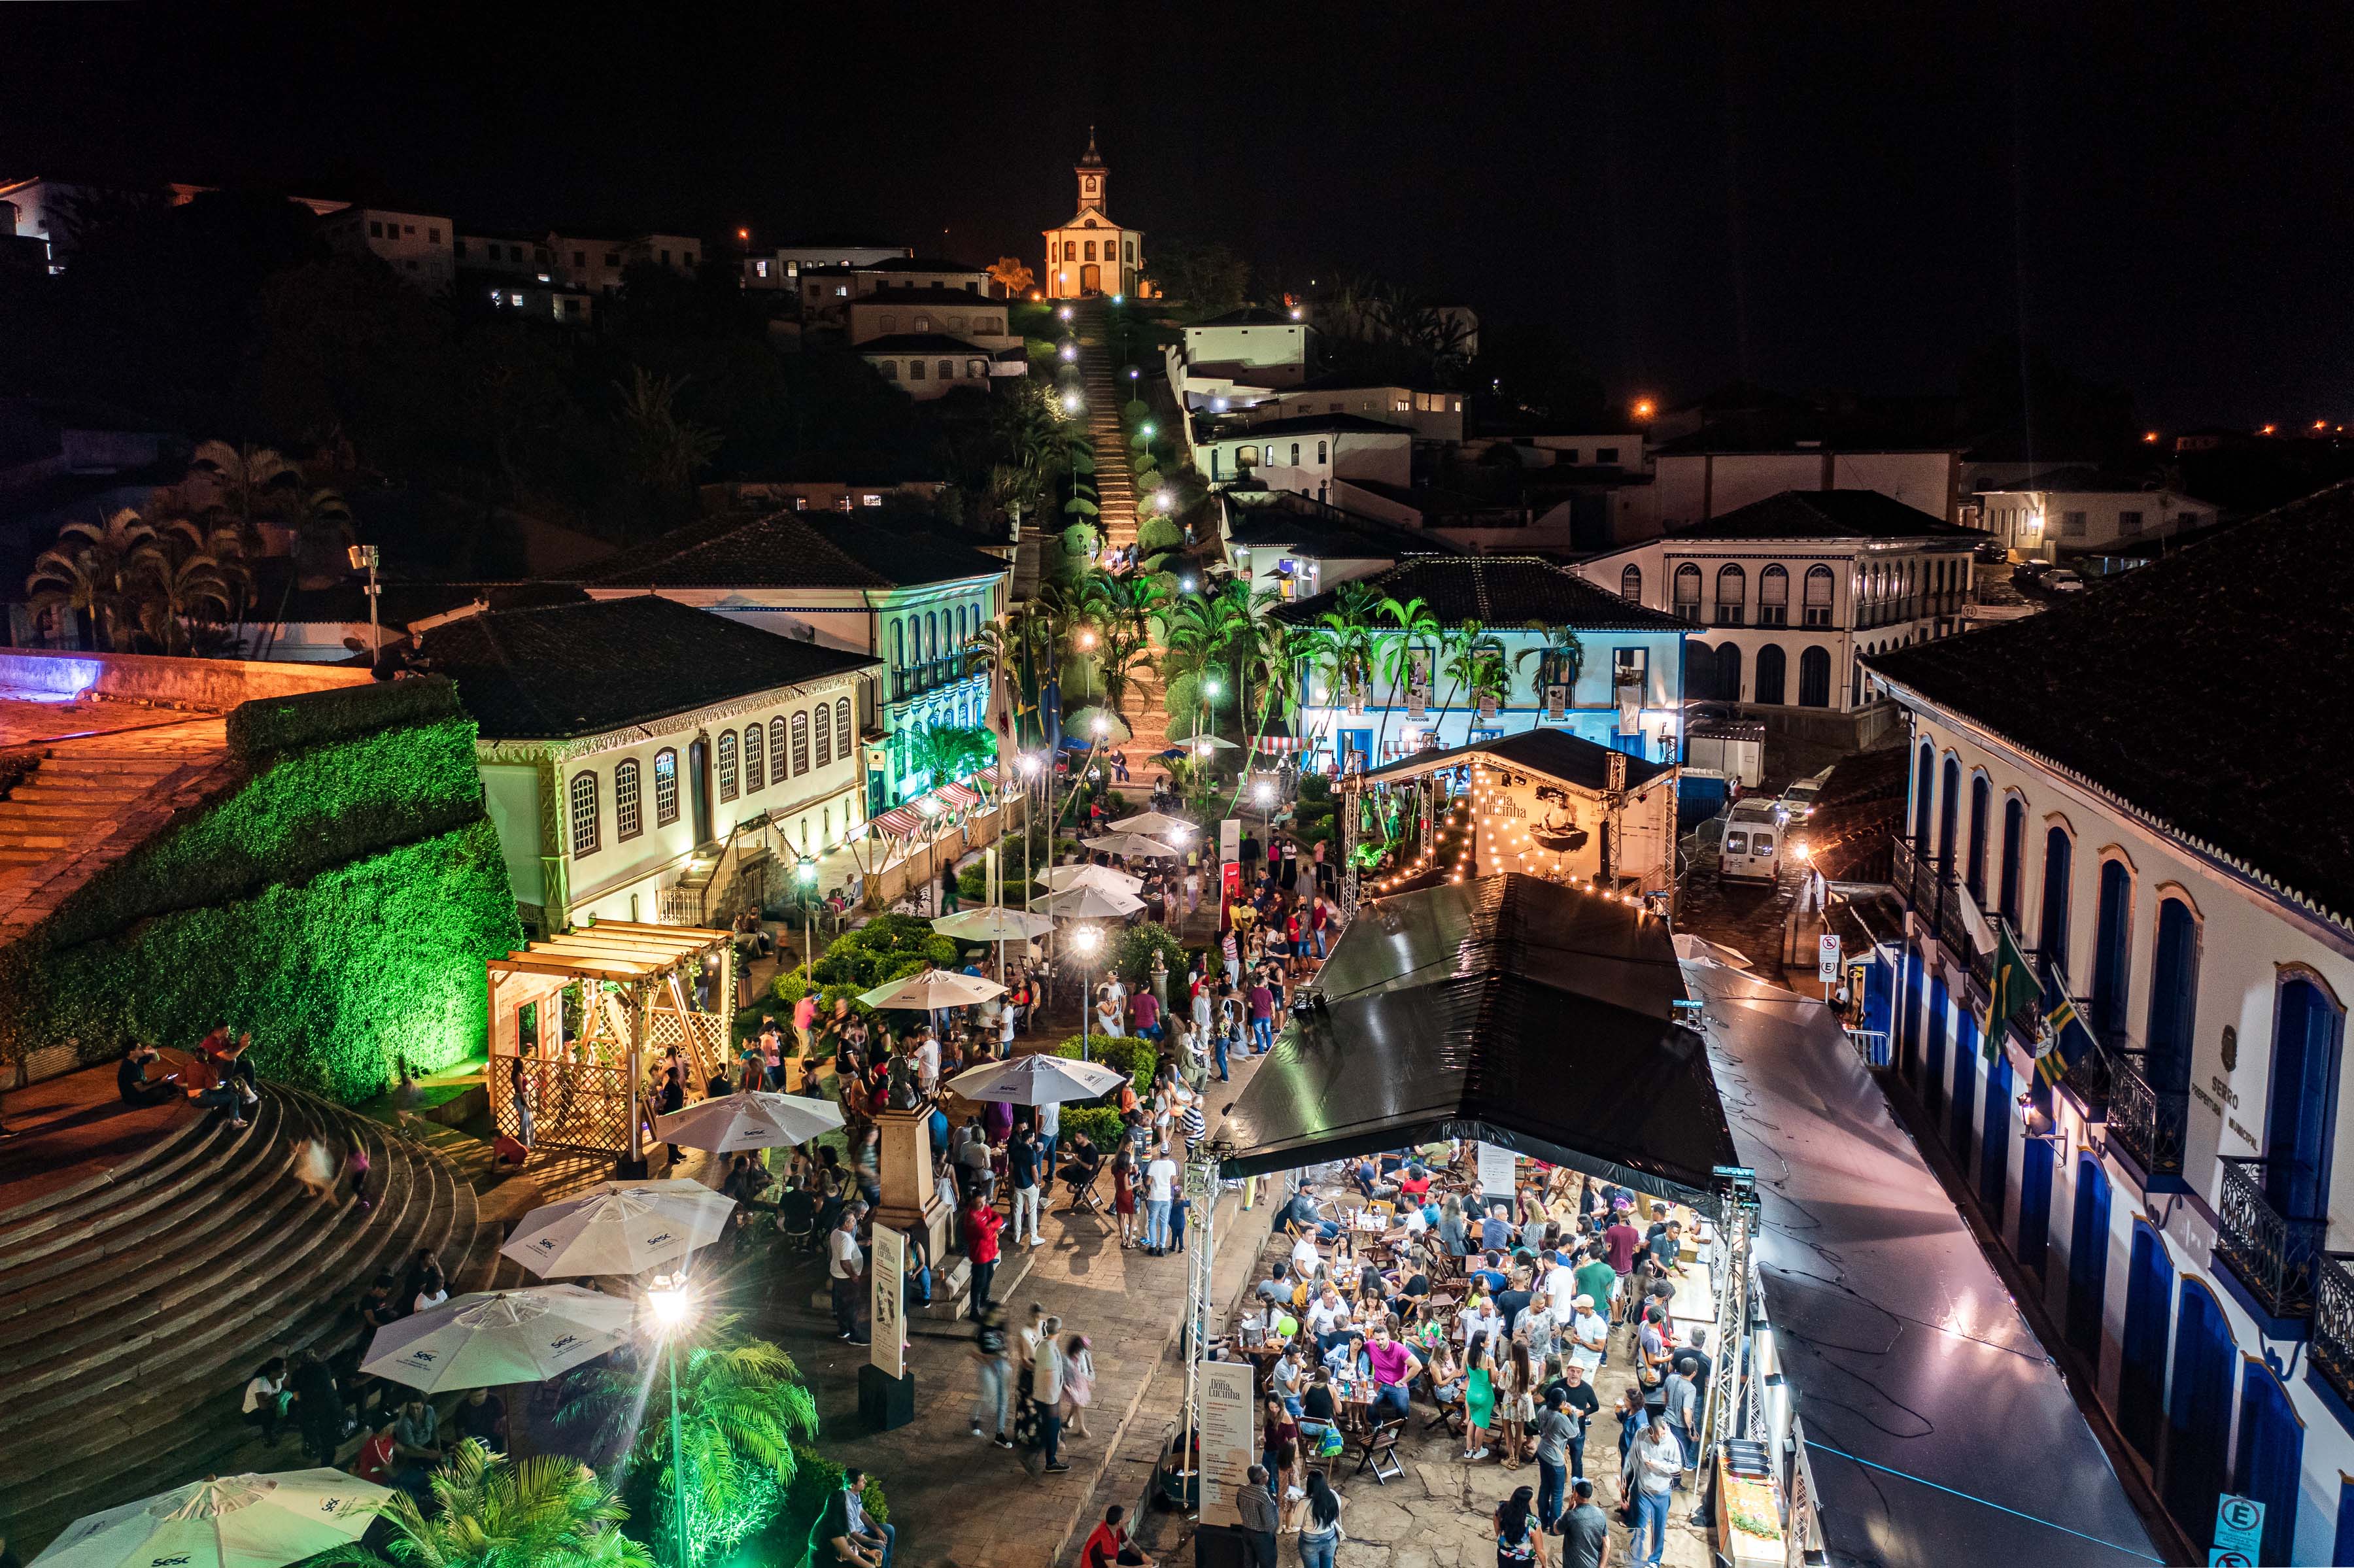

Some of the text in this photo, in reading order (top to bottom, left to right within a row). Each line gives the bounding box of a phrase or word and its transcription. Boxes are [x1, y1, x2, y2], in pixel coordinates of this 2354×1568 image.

[1486, 789, 1513, 807] Dona
[1483, 802, 1527, 819] Lucinha
[2211, 1076, 2238, 1110] SERRO
[2228, 1116, 2258, 1151] MUNICIPAL
[1208, 1386, 1240, 1400] Lucinha
[1211, 1378, 1230, 1391] Dona
[2232, 1504, 2250, 1525] E
